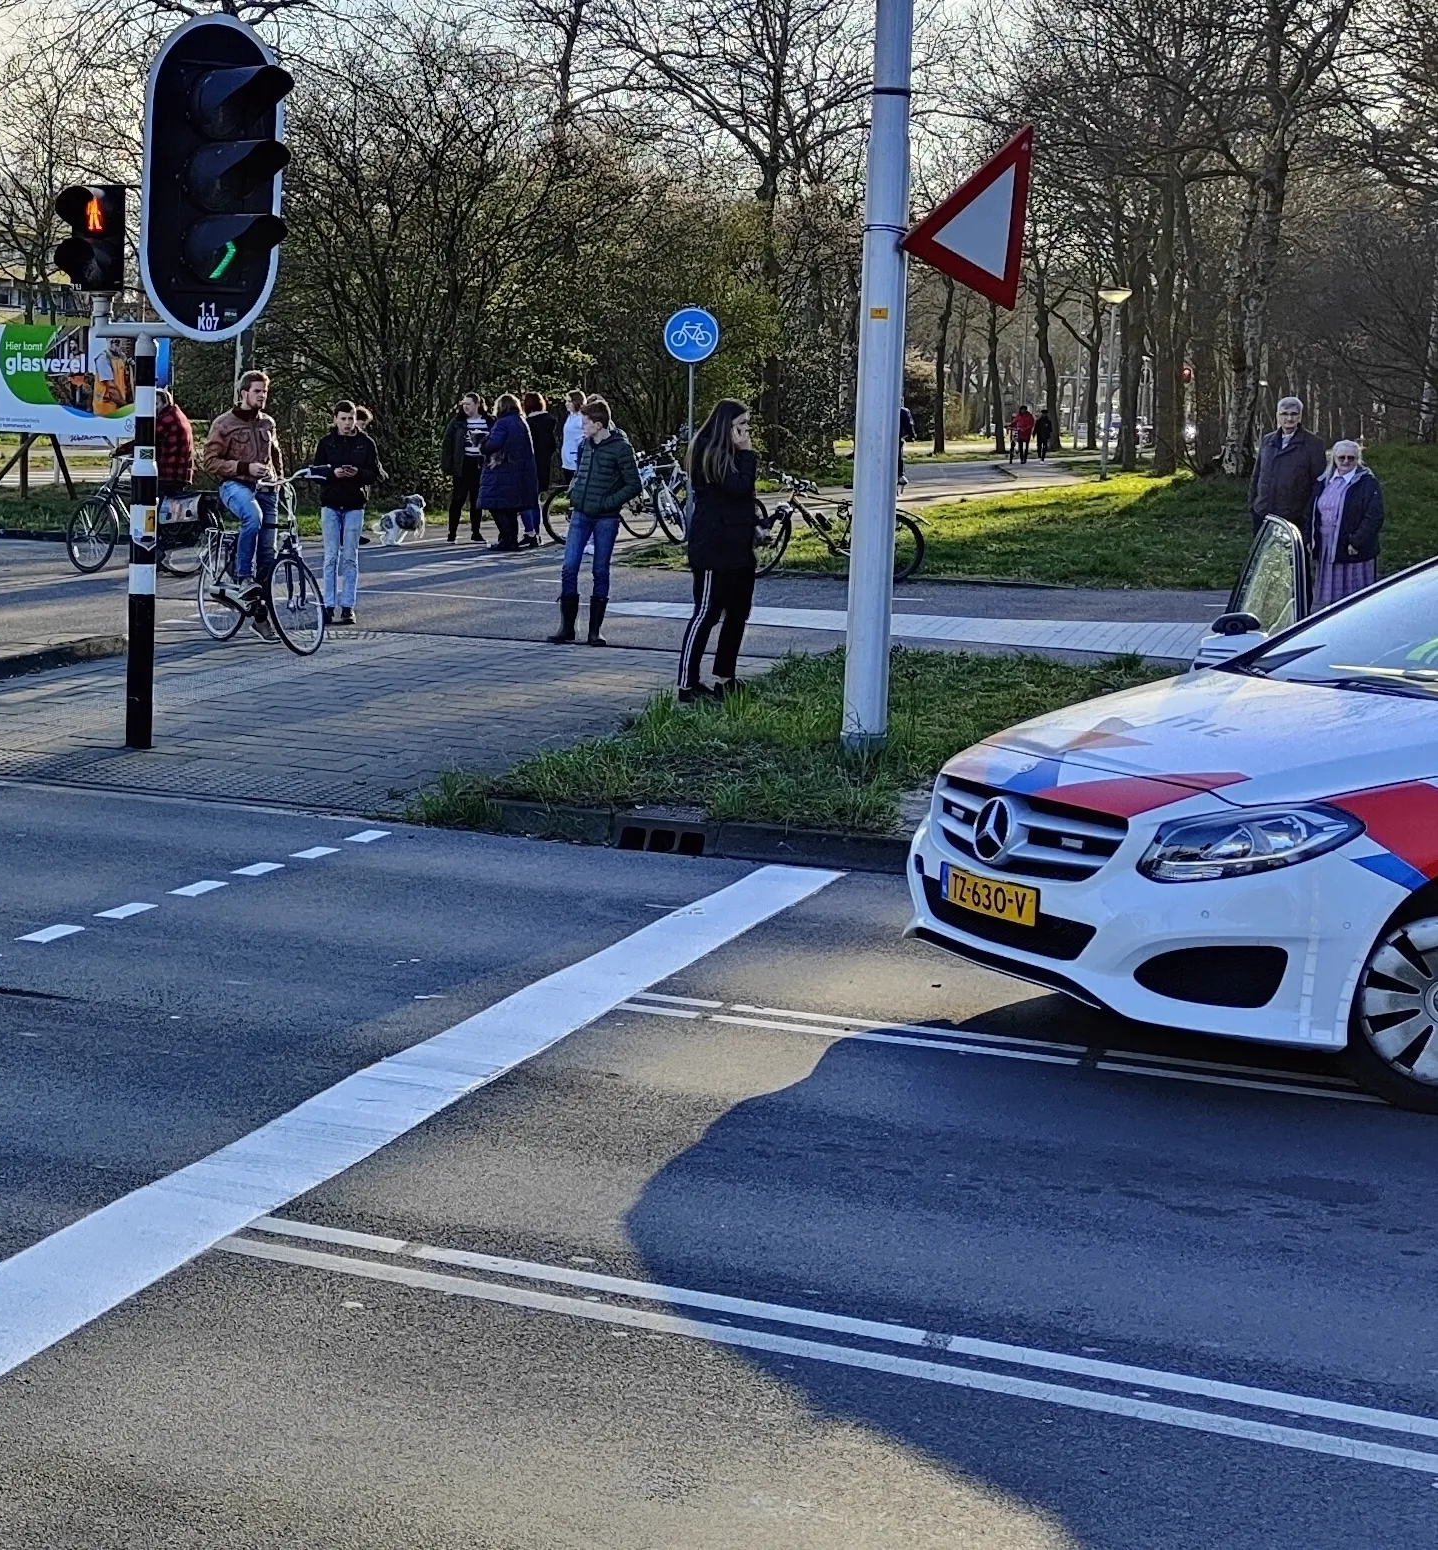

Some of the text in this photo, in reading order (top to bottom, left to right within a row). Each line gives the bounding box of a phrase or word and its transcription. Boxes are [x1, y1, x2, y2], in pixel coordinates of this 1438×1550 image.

[198, 301, 216, 317] 1.1
[197, 315, 220, 331] K07
[5, 341, 43, 351] Hier komt
[5, 352, 86, 376] glasvezel
[952, 872, 1026, 918] TZ-630-V
